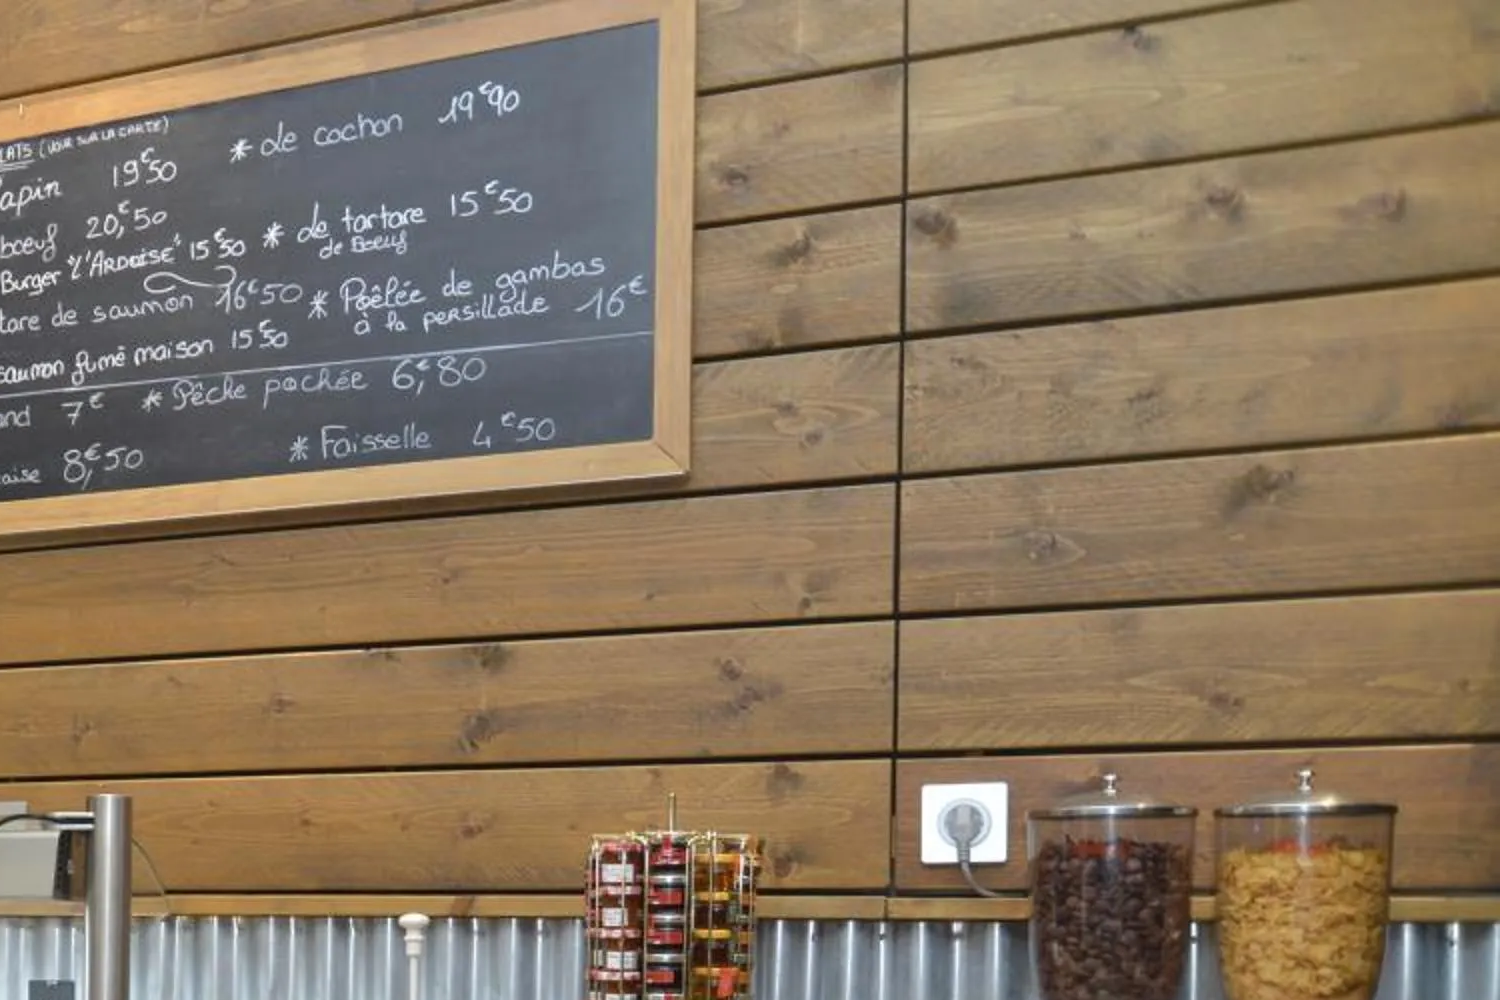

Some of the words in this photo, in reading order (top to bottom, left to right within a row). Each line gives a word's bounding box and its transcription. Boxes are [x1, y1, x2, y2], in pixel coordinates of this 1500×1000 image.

[260, 121, 299, 156] de
[314, 112, 403, 147] cochon
[297, 201, 329, 243] de
[342, 204, 427, 233] tartare
[319, 239, 343, 259] de
[0, 271, 61, 296] Burger
[442, 268, 473, 297] de
[495, 250, 605, 303] gambas
[52, 302, 78, 327] de
[92, 294, 192, 323] saumon
[134, 338, 213, 366] maison
[263, 368, 368, 408] pochée
[320, 423, 432, 460] Faisselle
